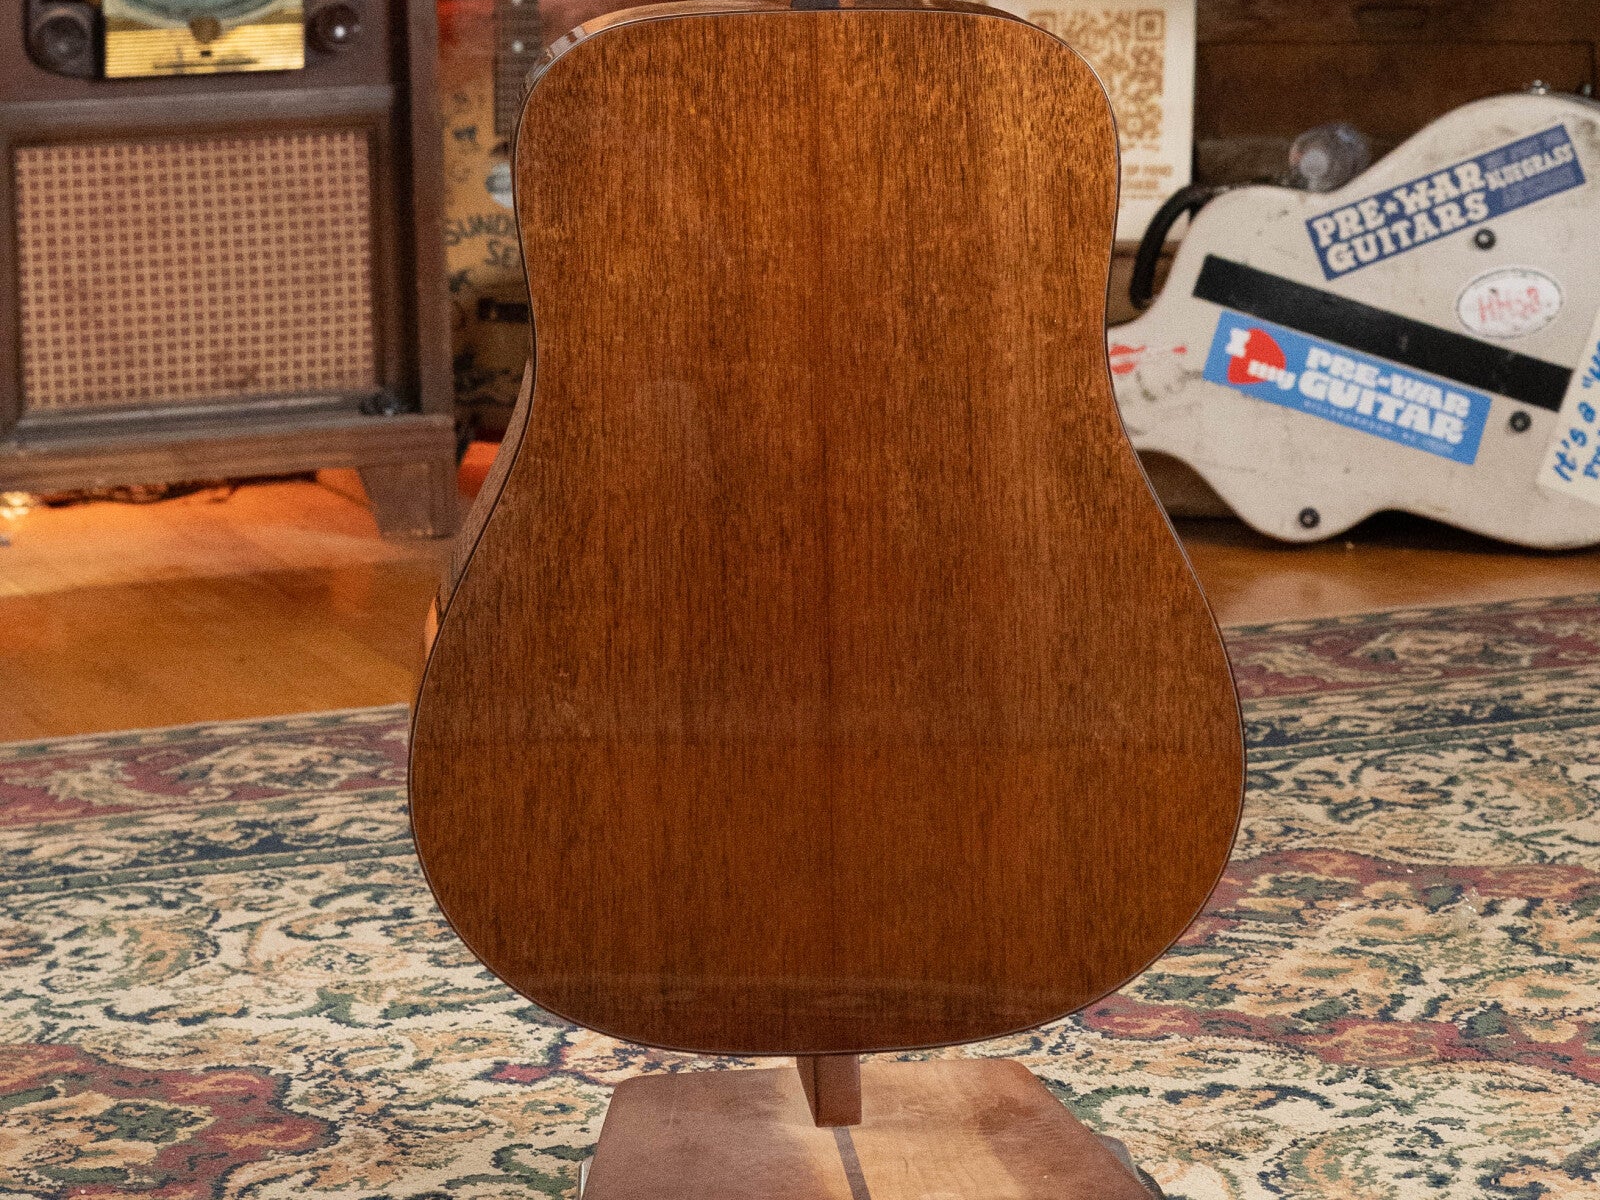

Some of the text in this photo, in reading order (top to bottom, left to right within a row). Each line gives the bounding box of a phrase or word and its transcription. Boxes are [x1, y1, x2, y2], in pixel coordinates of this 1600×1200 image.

[1326, 192, 1491, 273] GUITARS
[1247, 362, 1296, 389] my
[1299, 372, 1466, 443] GUITAR
[1305, 347, 1471, 419] PRE-WAR
